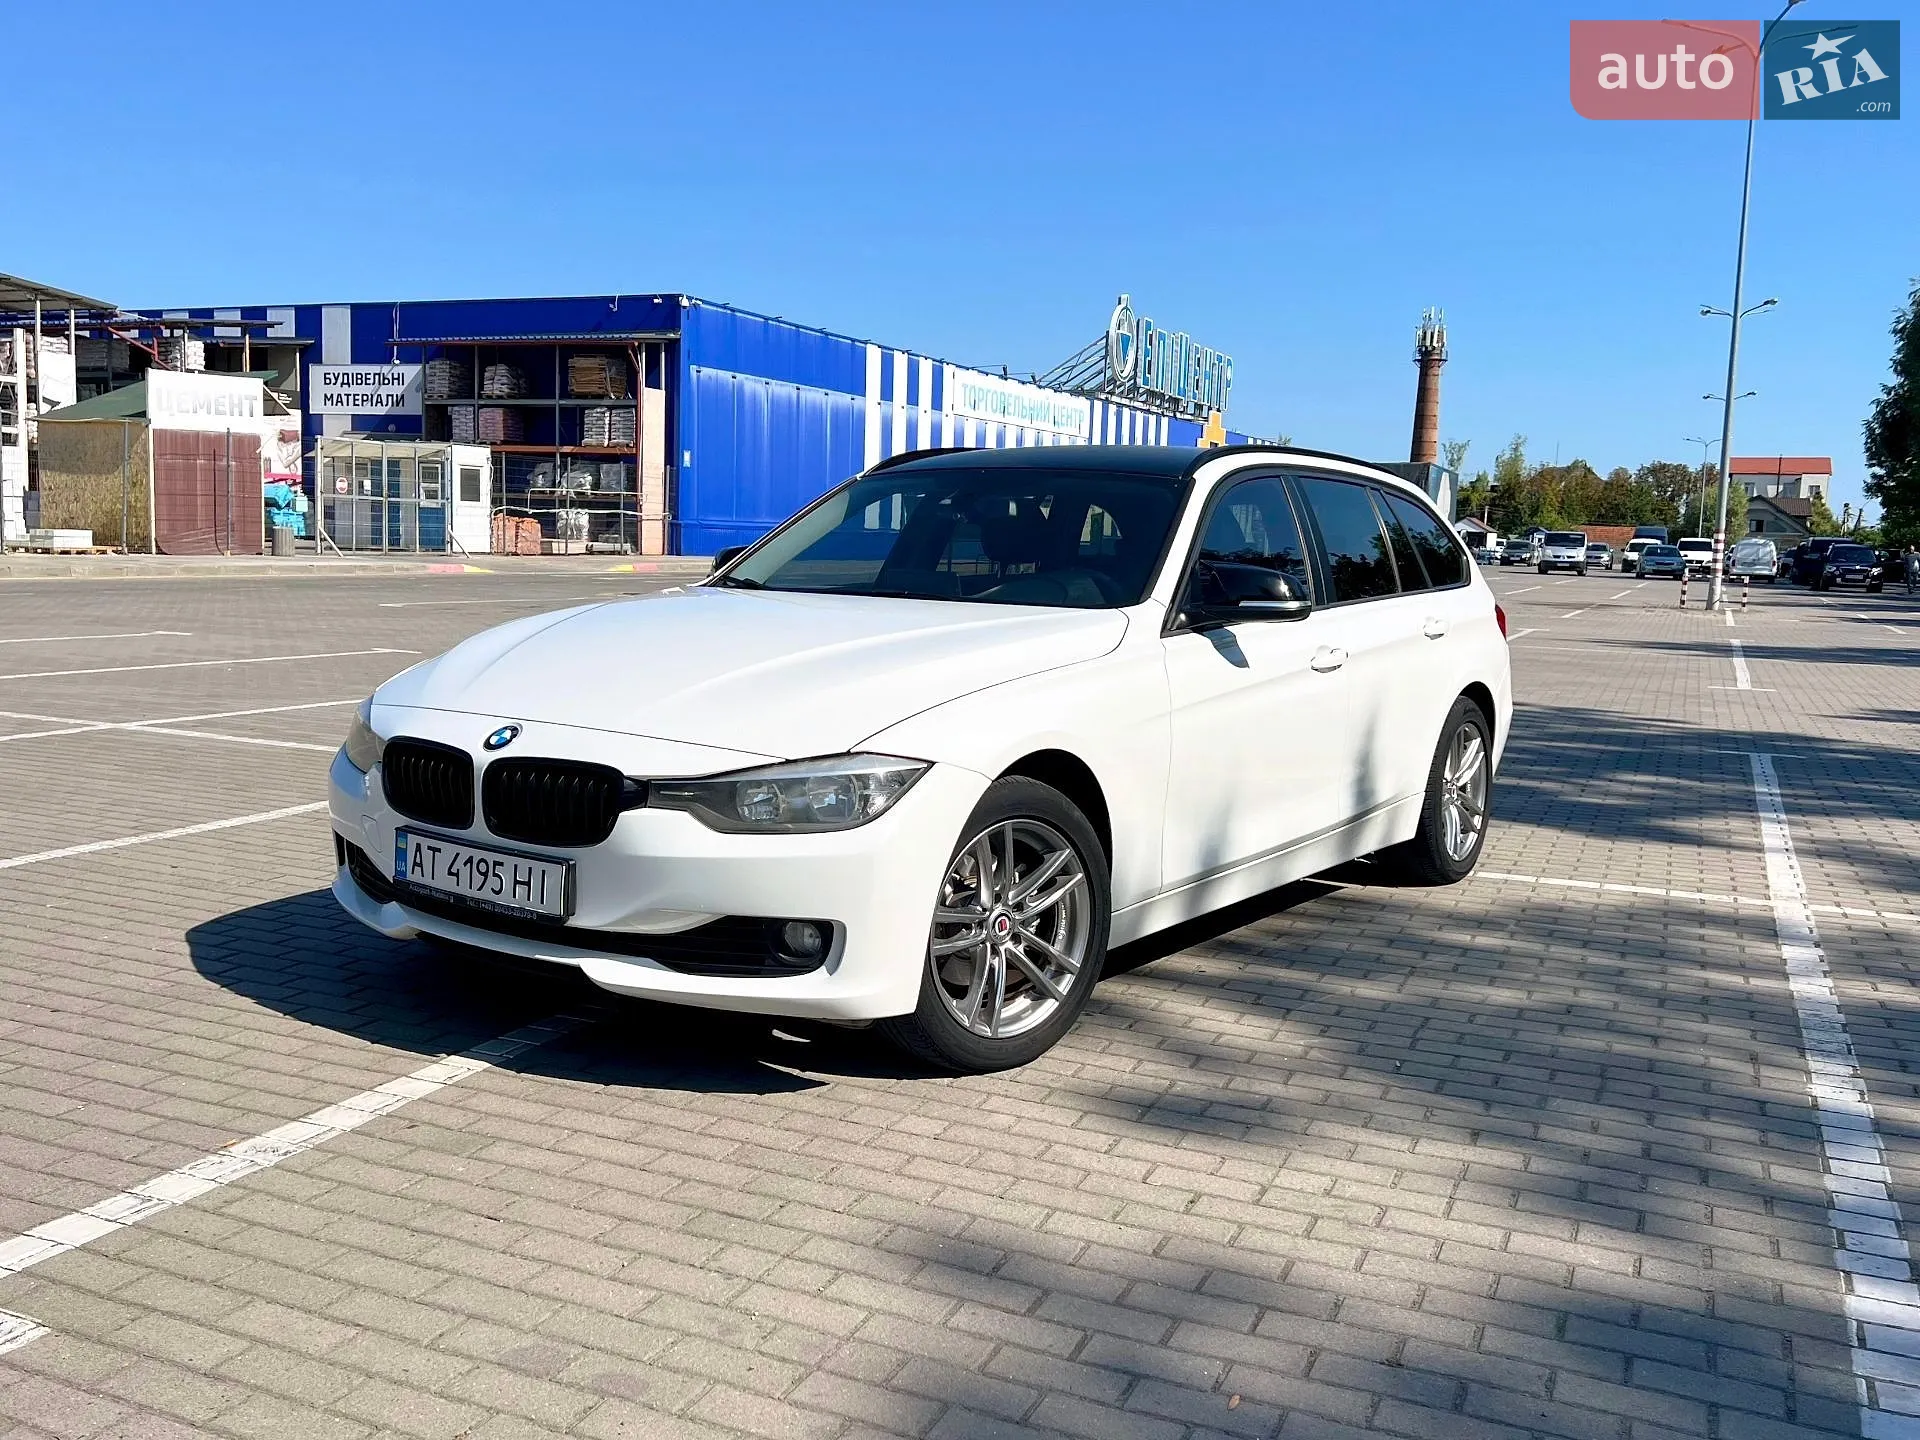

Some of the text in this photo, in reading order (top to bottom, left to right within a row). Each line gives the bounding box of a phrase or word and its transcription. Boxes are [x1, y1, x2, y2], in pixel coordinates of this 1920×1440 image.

[1138, 317, 1234, 411] ЕПІЦЕНТР
[323, 372, 405, 388] БУДІВЕЛЬНІ
[155, 387, 258, 418] ЦЕМЕНТ
[323, 393, 405, 408] МАТЕРІАЛИ
[962, 383, 1085, 431] ТОРГОВЕЛЬНИЙ ЦЕНТР
[396, 859, 407, 873] UA
[411, 843, 442, 881] AT
[447, 852, 505, 896] 4195
[512, 864, 547, 906] HI
